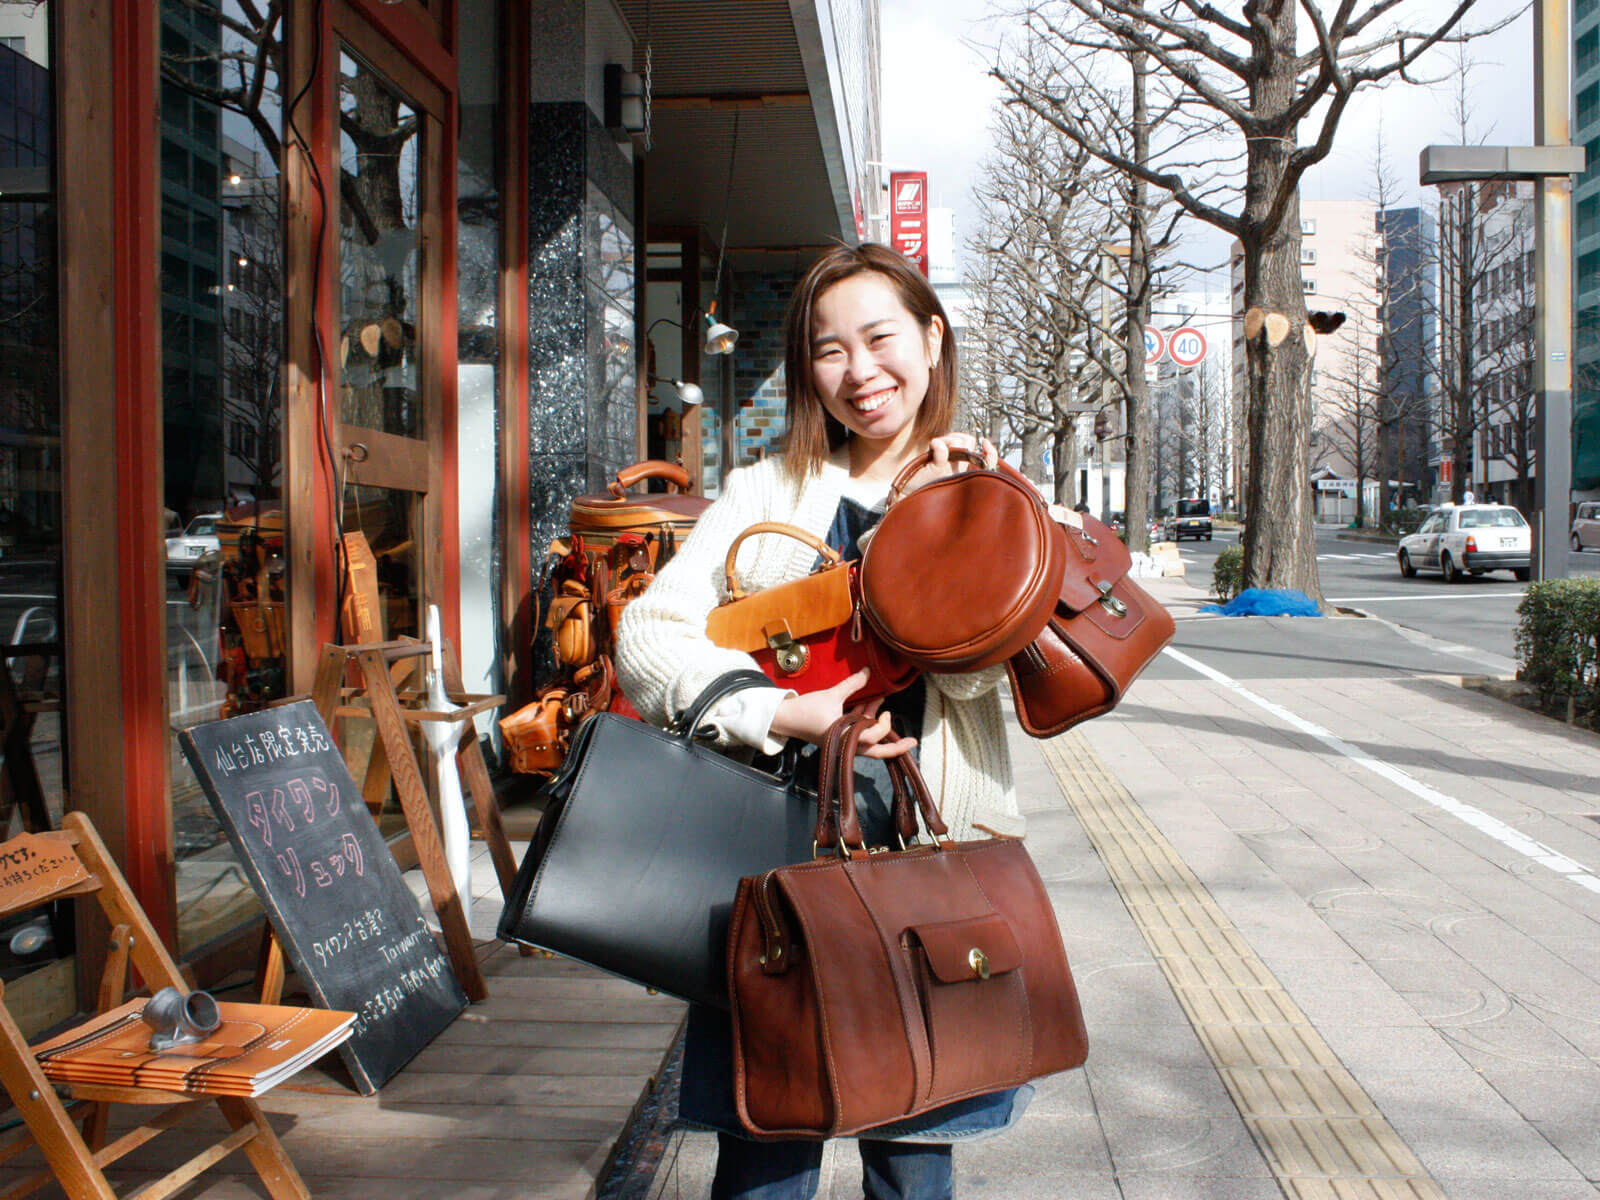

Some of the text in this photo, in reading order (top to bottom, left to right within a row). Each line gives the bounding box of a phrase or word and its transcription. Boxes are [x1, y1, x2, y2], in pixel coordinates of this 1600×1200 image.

[1177, 338, 1199, 355] 40
[215, 722, 329, 777] 仙台店限定発売
[246, 776, 340, 846] タイワン
[276, 833, 364, 898] リュック
